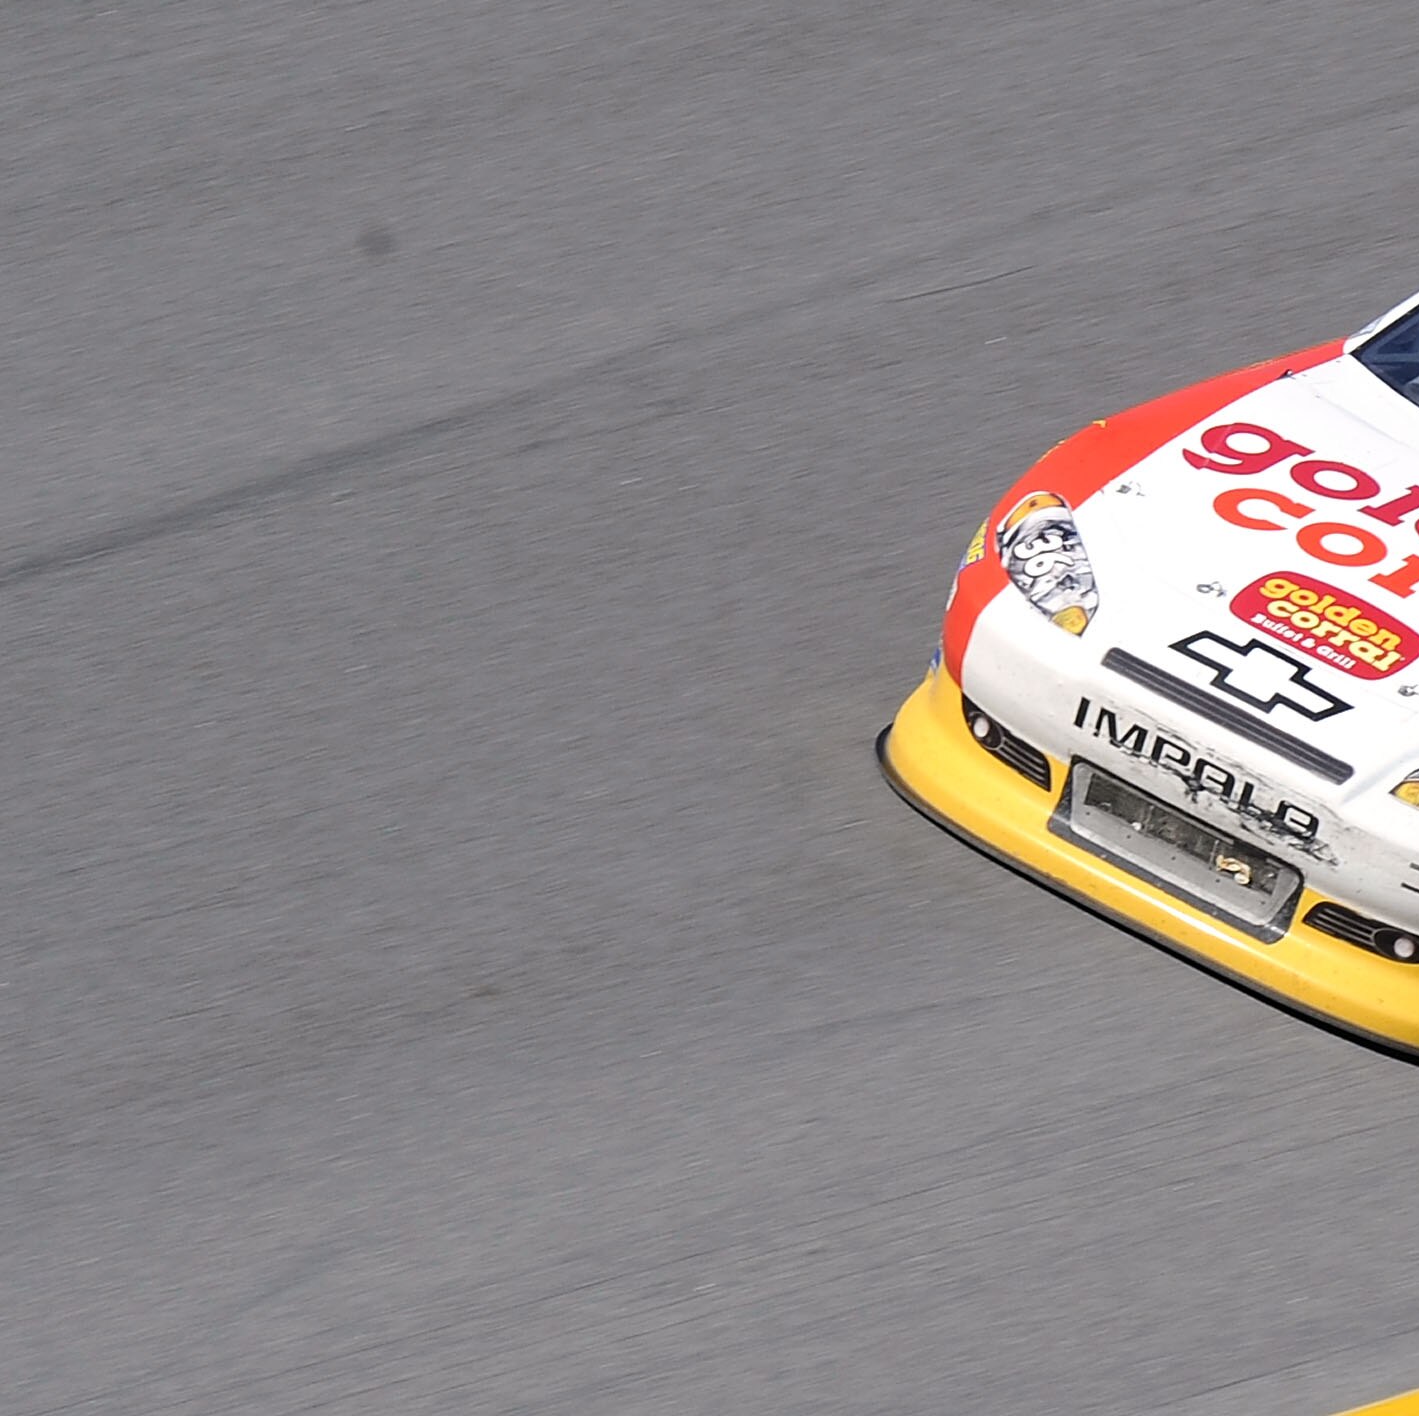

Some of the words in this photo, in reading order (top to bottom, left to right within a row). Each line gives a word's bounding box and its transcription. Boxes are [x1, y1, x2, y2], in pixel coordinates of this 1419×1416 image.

[1012, 534, 1075, 578] 36
[1251, 613, 1304, 642] Buffet
[1316, 645, 1358, 669] Grill
[1259, 578, 1402, 651] golden
[1267, 600, 1402, 672] corral
[1074, 696, 1320, 842] IMPALA
